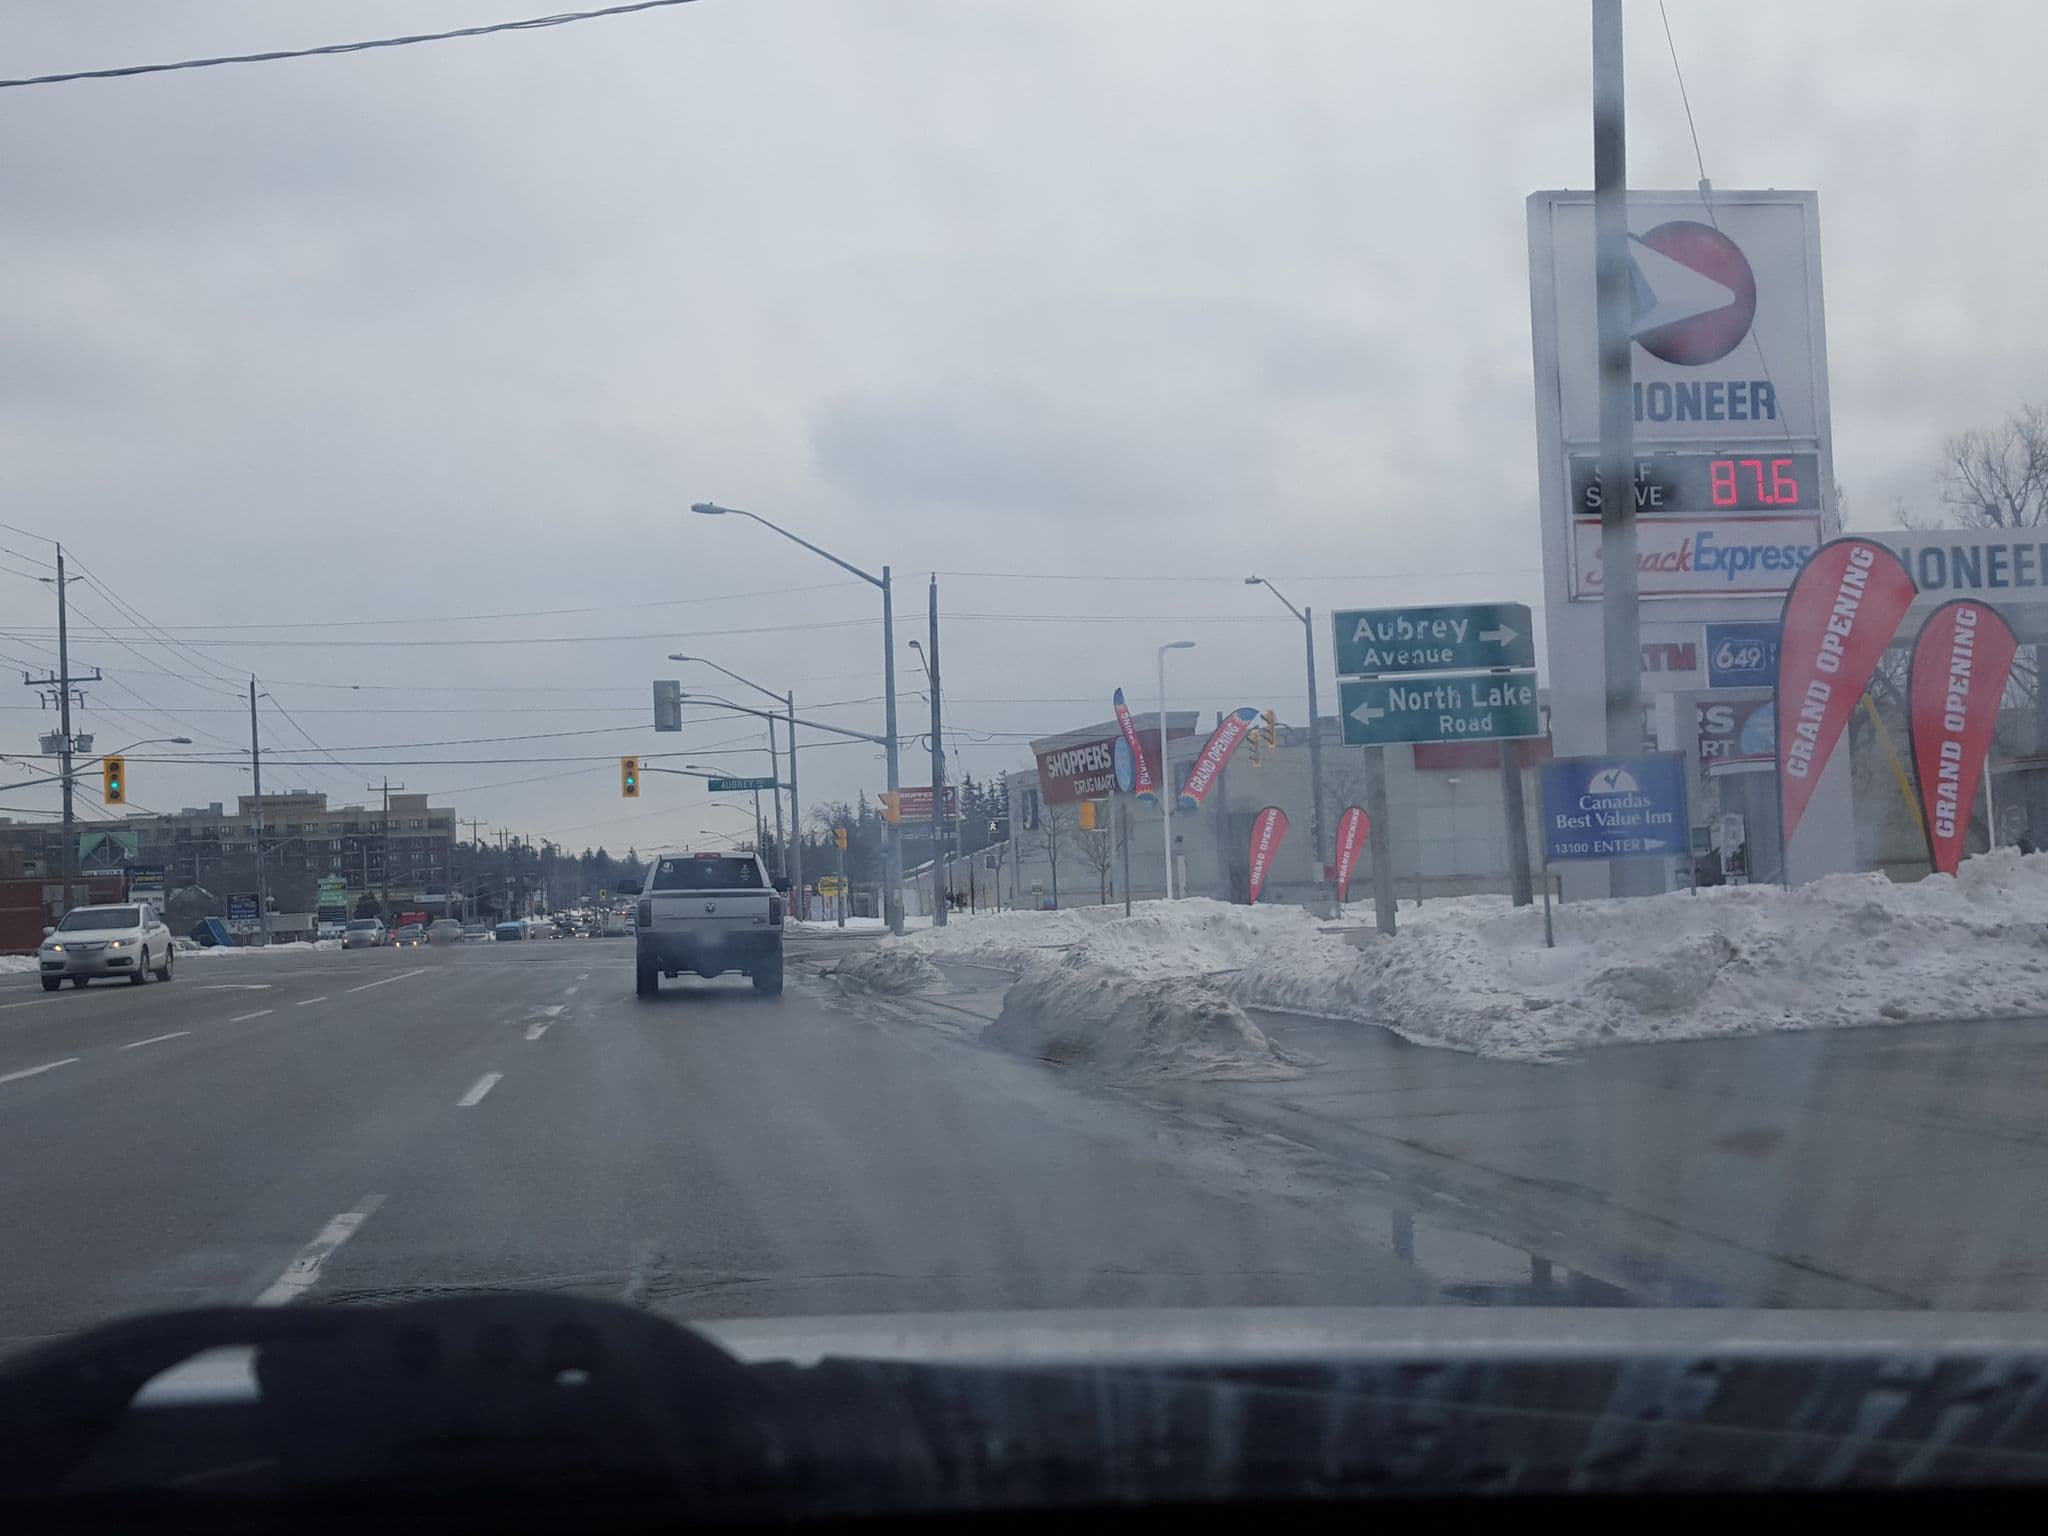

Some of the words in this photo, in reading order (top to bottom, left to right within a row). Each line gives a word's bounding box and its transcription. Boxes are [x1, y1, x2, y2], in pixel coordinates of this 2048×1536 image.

[1633, 381, 1777, 422] IONEER
[1710, 459, 1799, 506] 87.6
[1586, 486, 1664, 507] SVE
[1352, 617, 1469, 643] Aubrey
[1363, 648, 1454, 666] Avenue
[1786, 680, 1832, 779] GRAND
[1815, 546, 1875, 674] OPENING
[1943, 607, 1978, 732] OPENING
[1388, 685, 1461, 713] North
[1471, 682, 1533, 708] Lake
[1440, 712, 1493, 734] Road
[1046, 743, 1112, 779] SHOPPERS
[1190, 759, 1217, 792] GRAND
[1207, 722, 1239, 762] OPENING
[721, 780, 755, 789] AUBREY
[1073, 778, 1095, 795] DRUG
[1095, 774, 1117, 792] MART
[1935, 740, 1962, 838] GRAND
[1580, 793, 1652, 811] Canadas
[1556, 814, 1592, 829] Best
[1595, 810, 1641, 827] Value
[1646, 810, 1673, 825] Inn
[1555, 843, 1589, 854] 13100
[1594, 839, 1641, 853] ENTER
